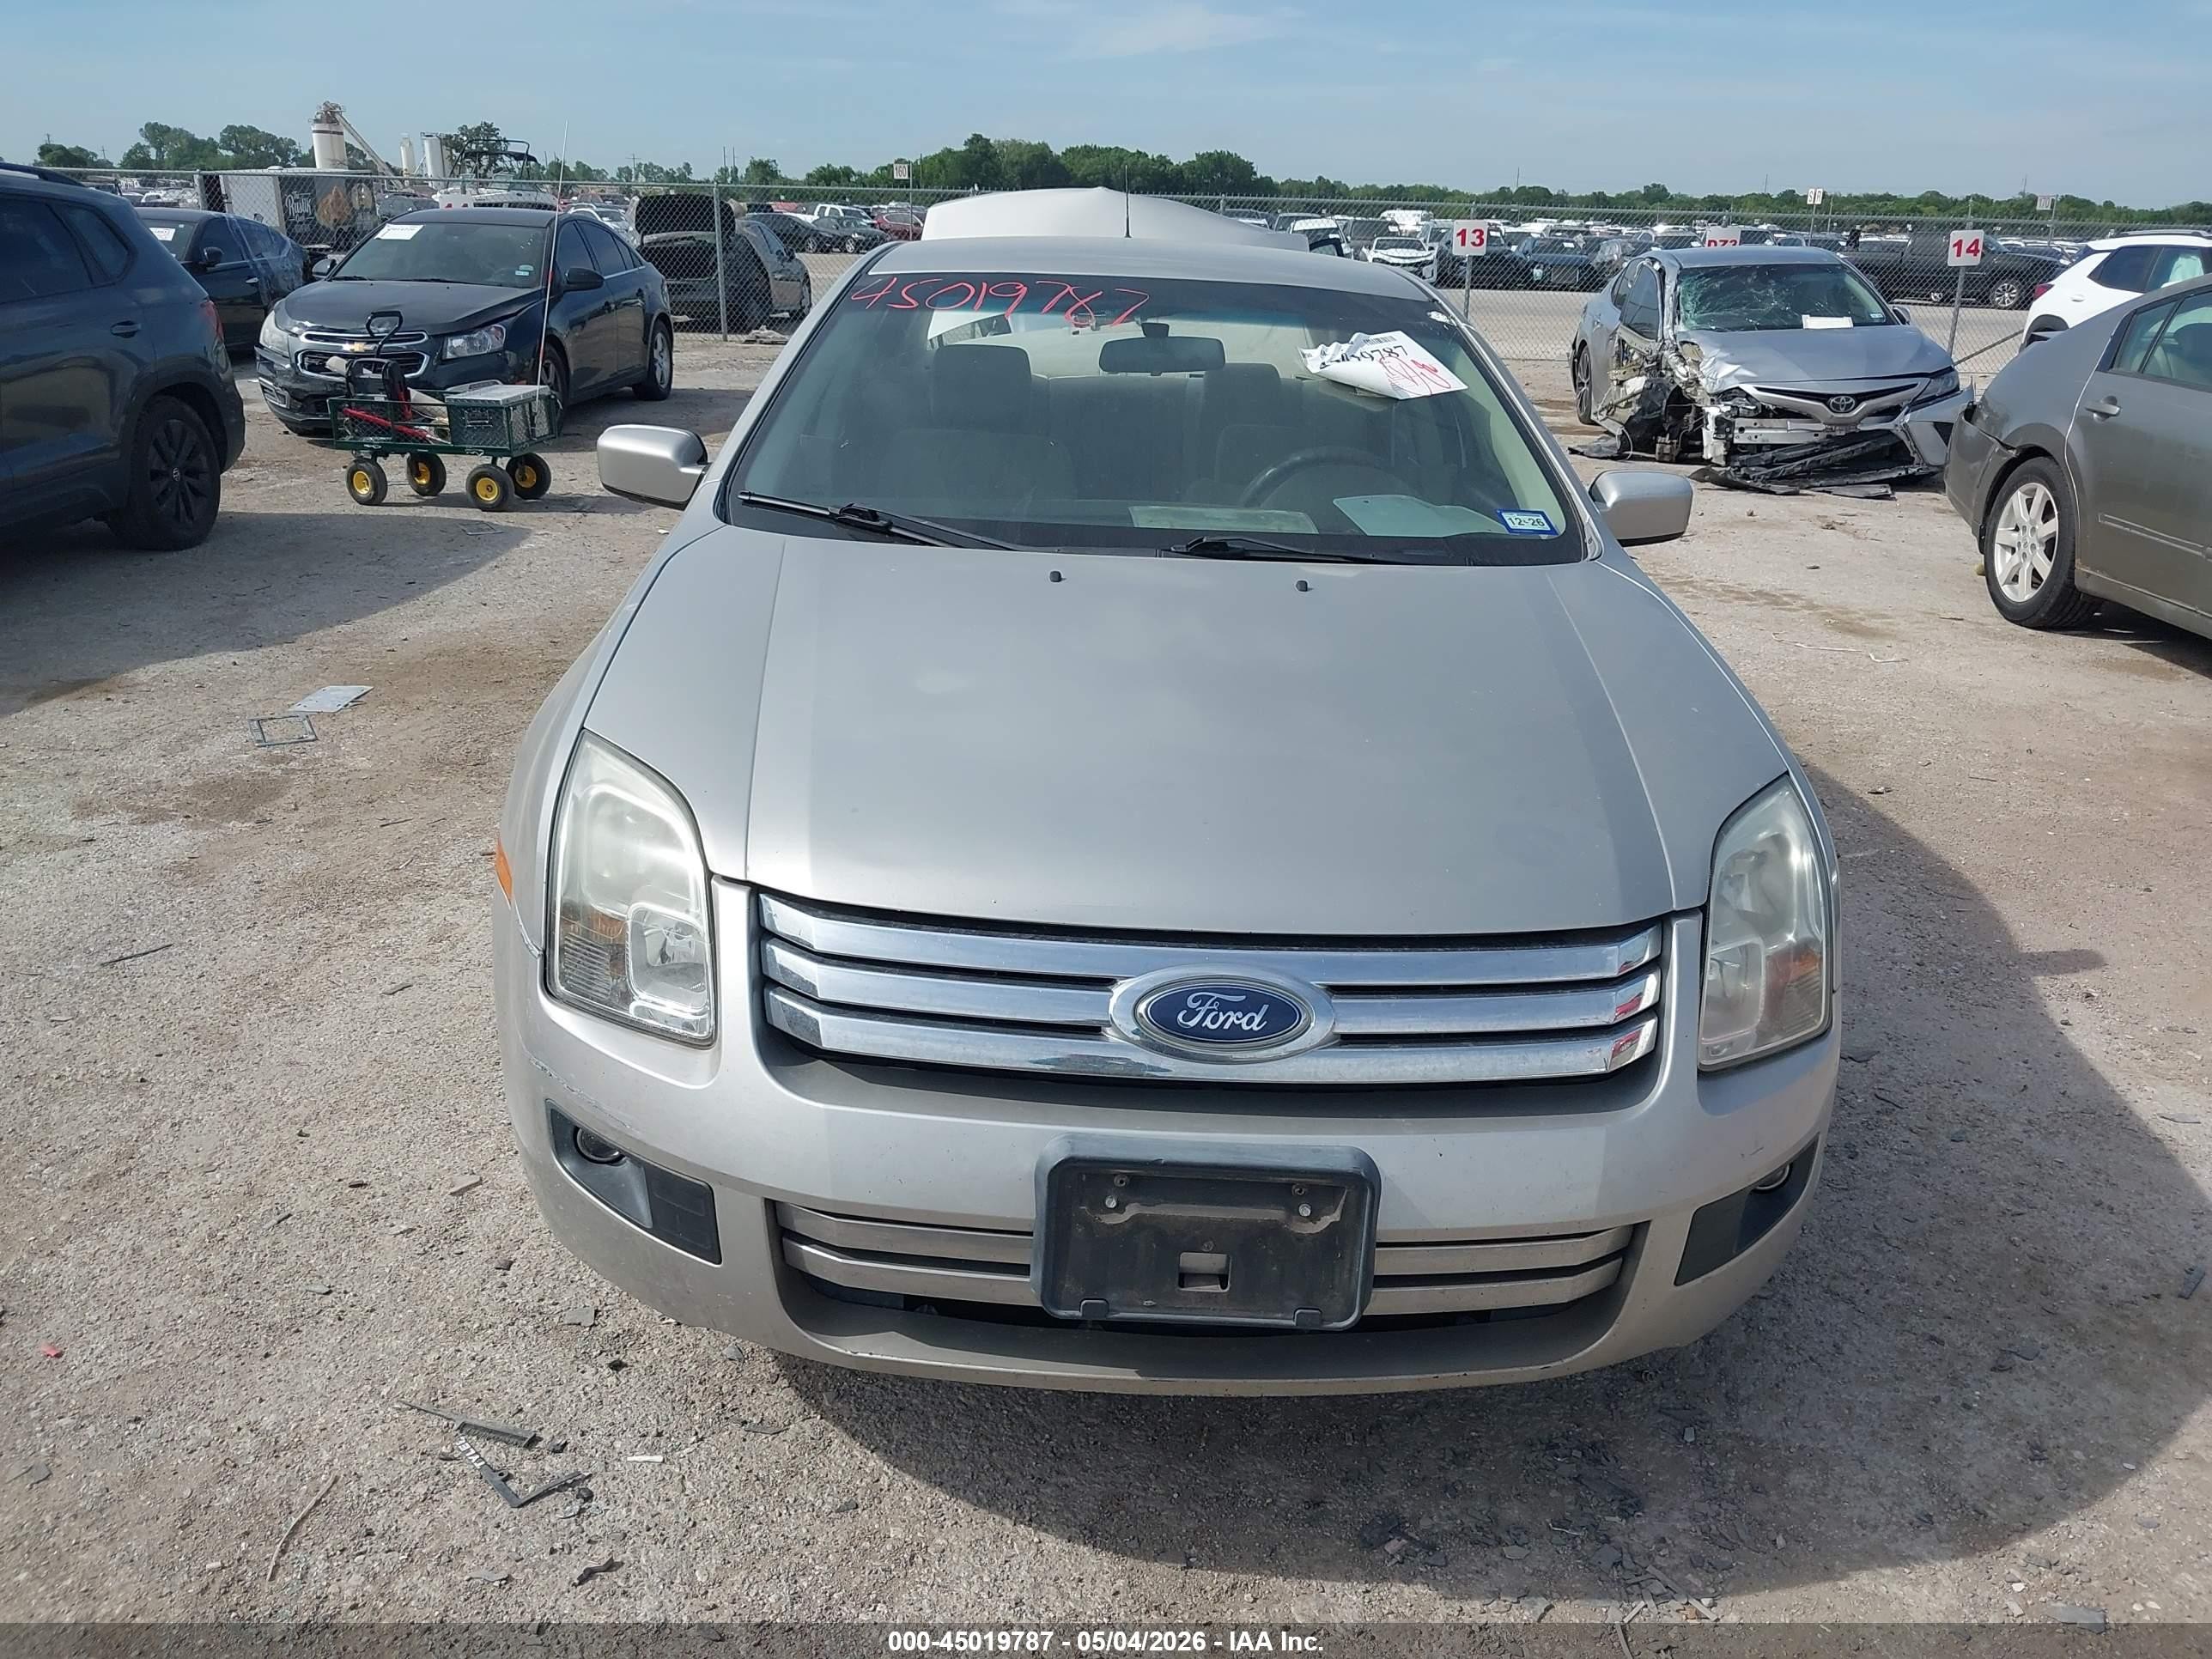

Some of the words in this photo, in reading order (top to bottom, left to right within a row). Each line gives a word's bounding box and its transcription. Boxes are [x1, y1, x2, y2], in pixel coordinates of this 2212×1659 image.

[895, 165, 907, 177] 160
[1455, 228, 1485, 247] 13
[1952, 238, 1980, 258] 14
[851, 276, 1150, 327] 45019787
[1176, 992, 1269, 1030] Ford
